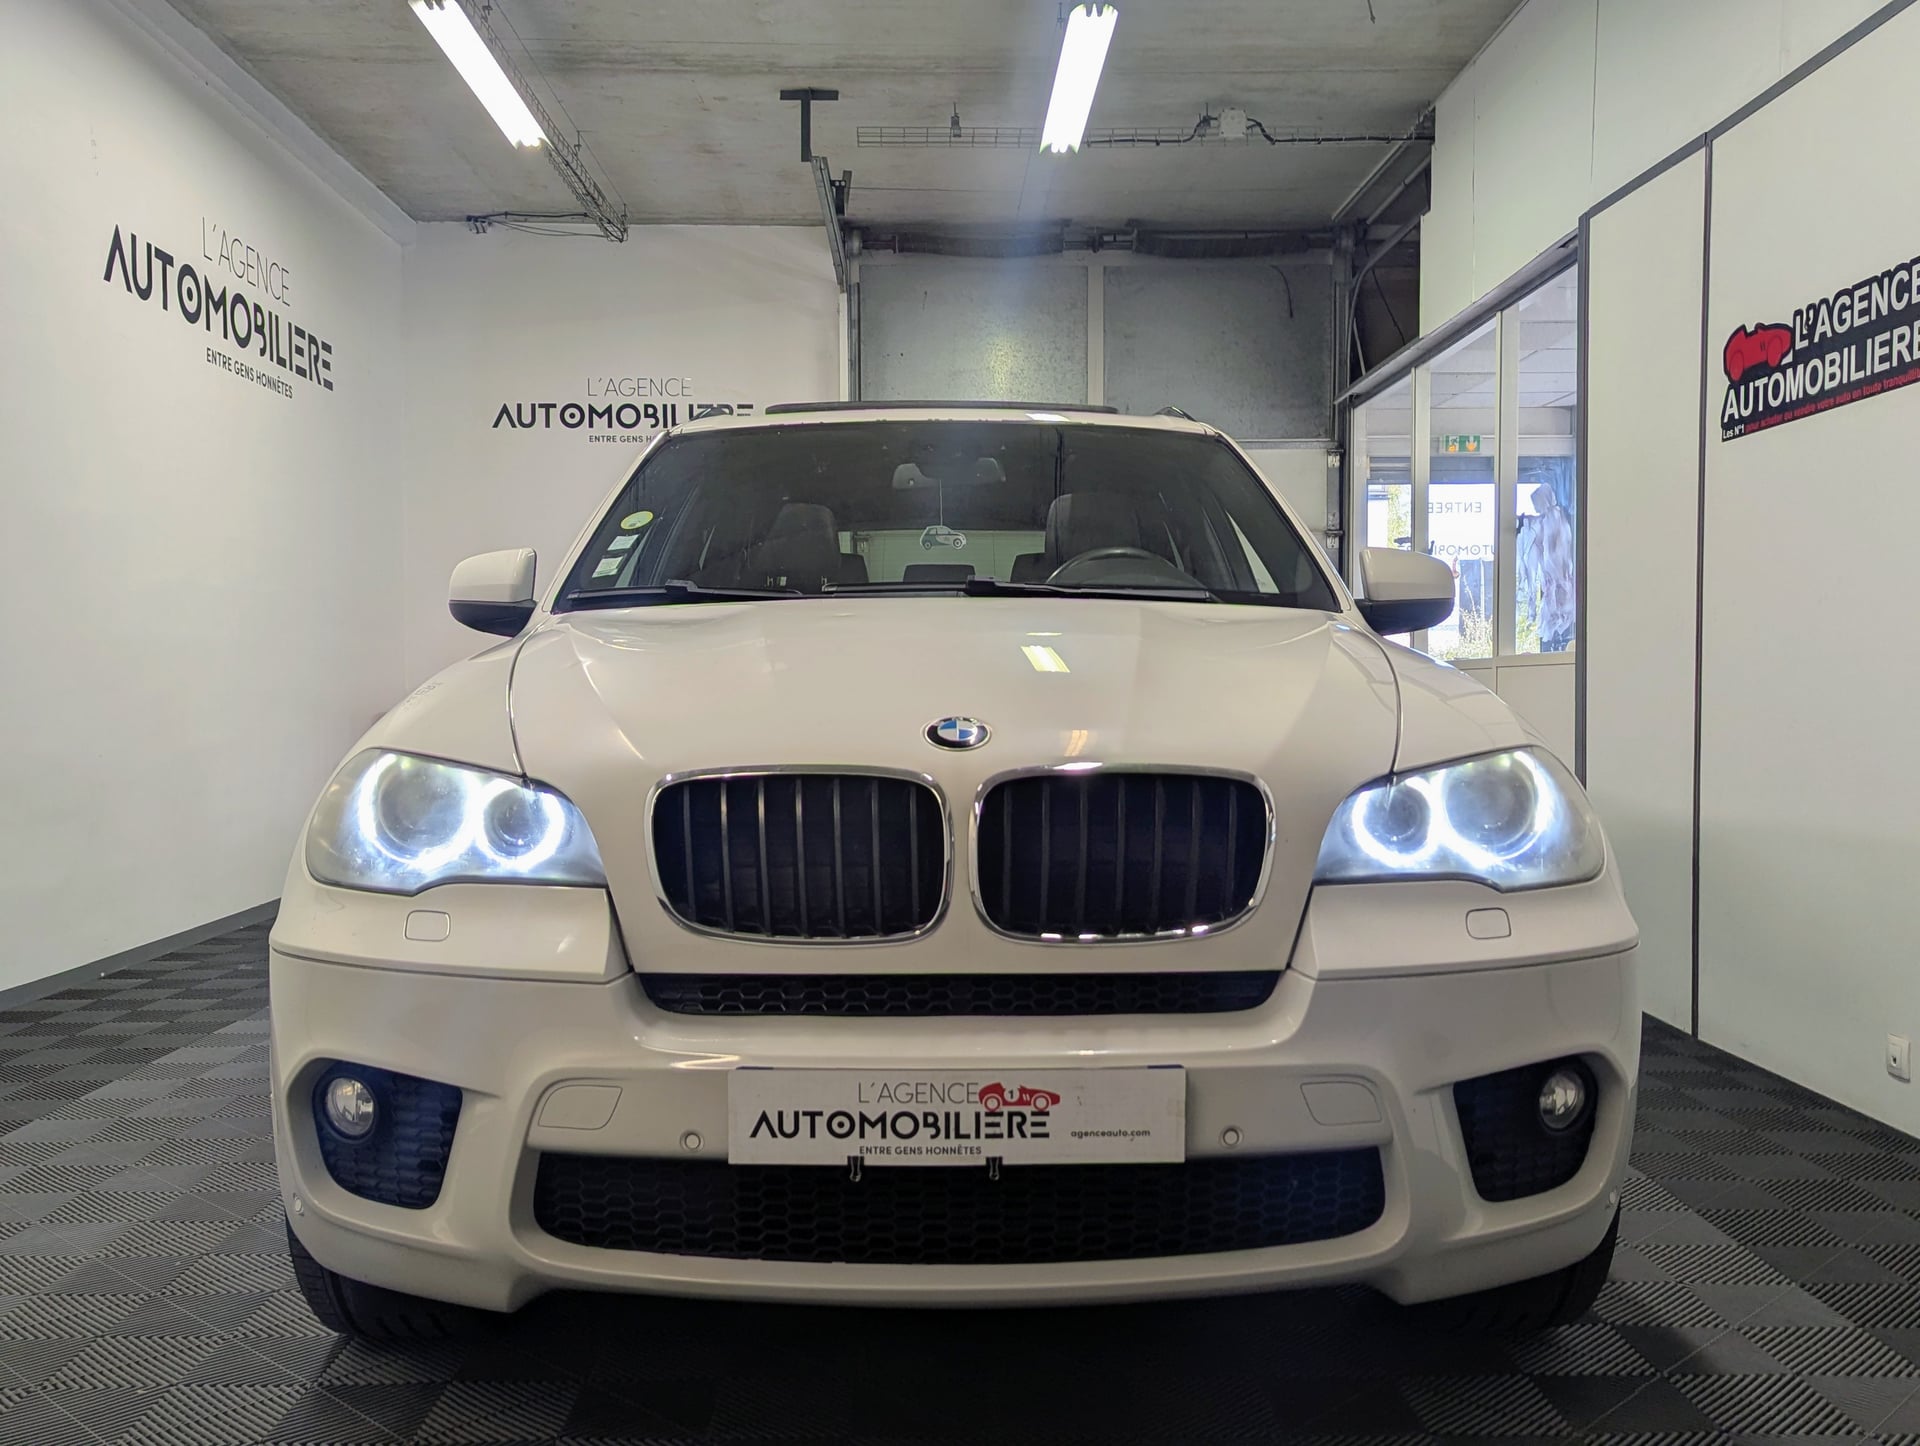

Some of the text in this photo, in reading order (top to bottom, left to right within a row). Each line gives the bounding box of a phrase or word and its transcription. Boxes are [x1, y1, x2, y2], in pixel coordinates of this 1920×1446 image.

[202, 216, 291, 307] L'AGENCE
[103, 223, 334, 392] AUTOMOBILIERE
[1794, 261, 1920, 351] L'AGENCE
[206, 346, 294, 400] ENTRE GENS HONNÊTES
[586, 377, 693, 398] L'AGENCE
[588, 435, 617, 444] ENTRE
[619, 435, 644, 444] GENS
[1723, 429, 1734, 440] Les
[857, 1081, 980, 1105] L'AGENCE
[749, 1109, 1050, 1140] AUTOMOBILIERE
[1070, 1128, 1151, 1140] agenceauto.com
[858, 1143, 982, 1156] ENTRE GENS HONNÊTES
